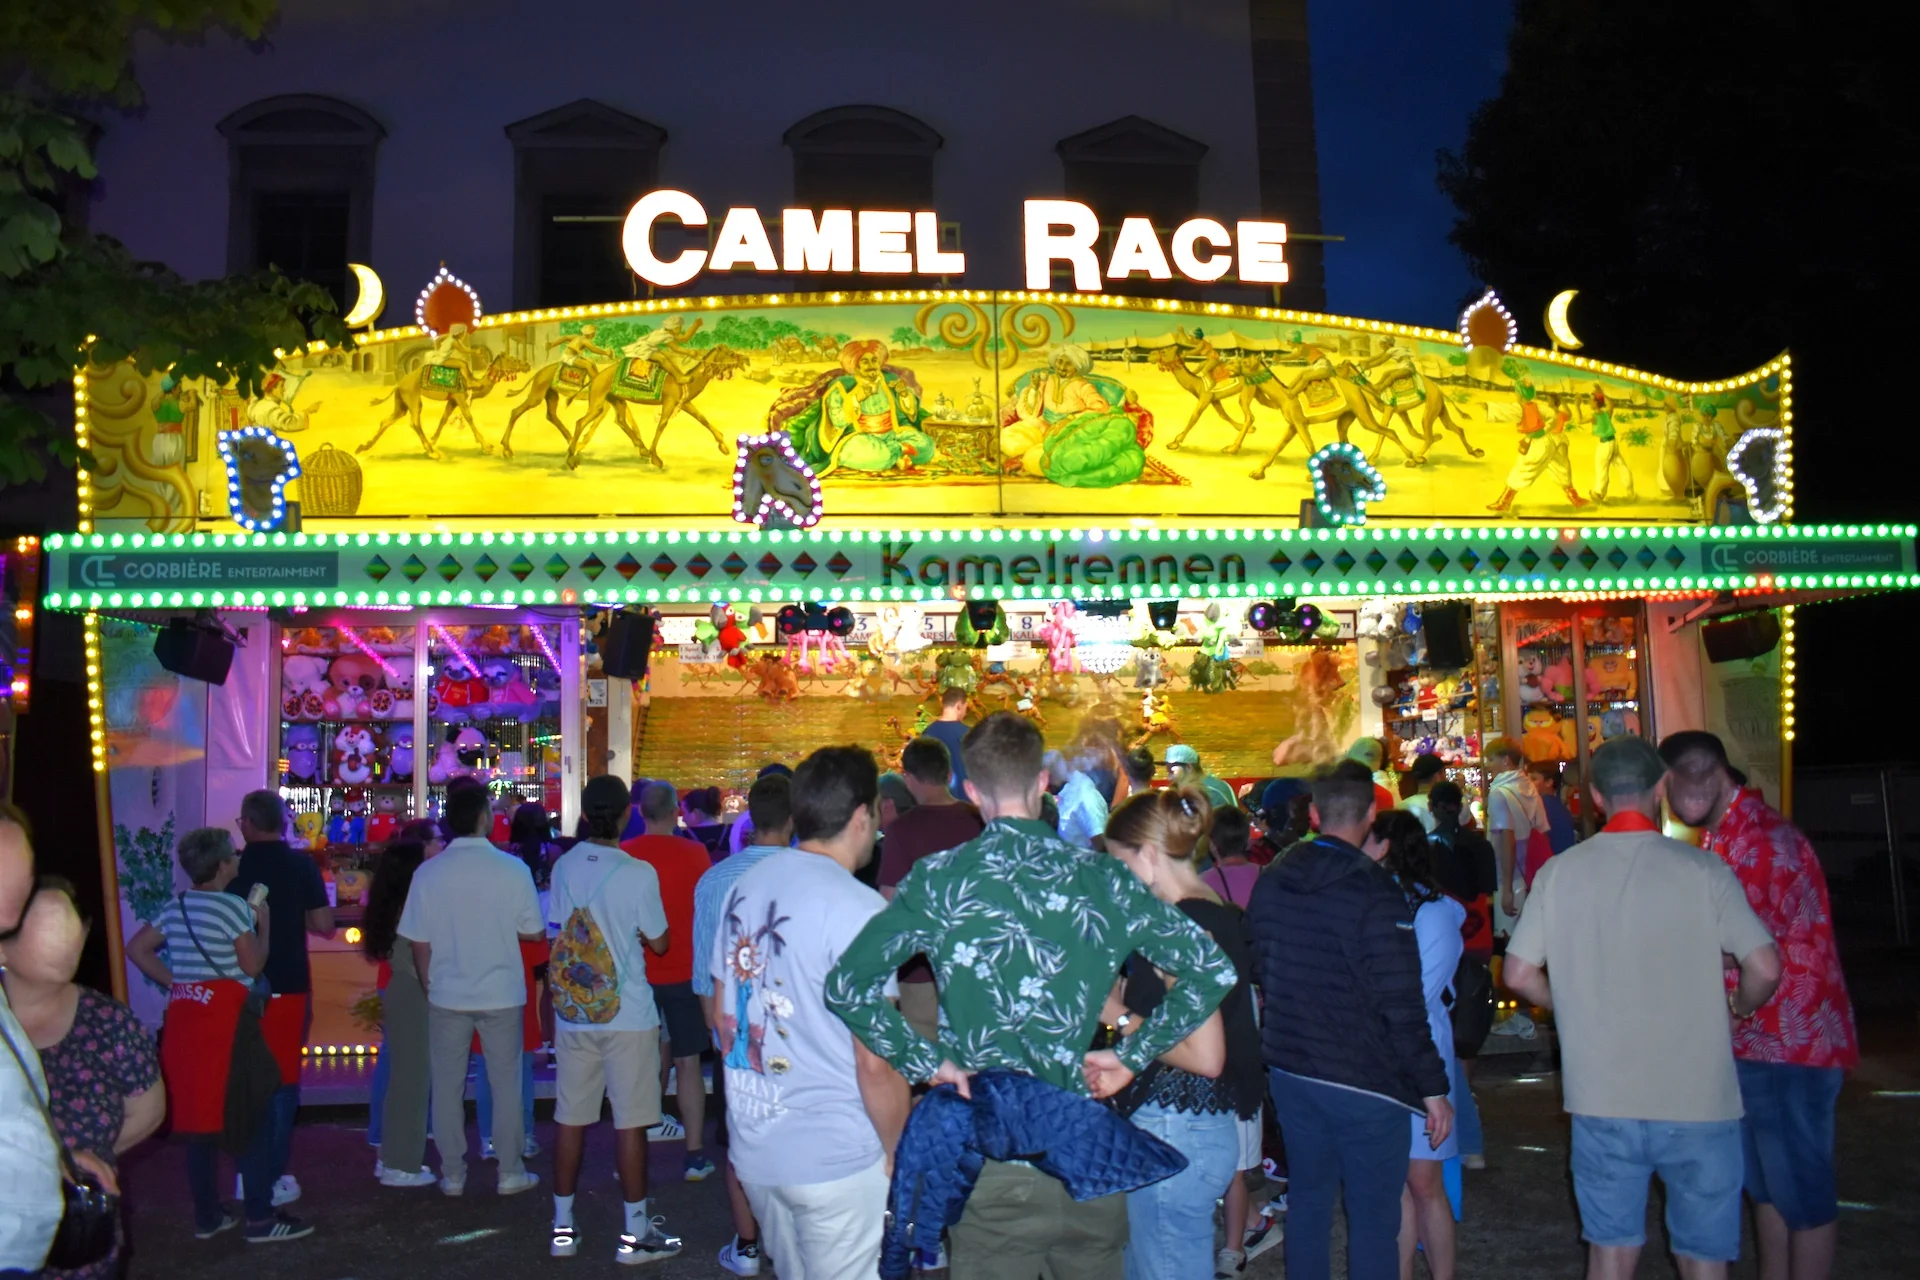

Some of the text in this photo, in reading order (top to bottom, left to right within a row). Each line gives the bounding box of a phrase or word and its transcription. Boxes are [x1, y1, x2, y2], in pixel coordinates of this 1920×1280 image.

[622, 188, 1291, 292] CAMEL RACE
[880, 541, 1247, 587] Kamelrennen
[1743, 546, 1819, 565] CORBIÈRE
[1821, 553, 1895, 565] ENTERTAINMENT
[123, 557, 223, 579] CORBIÈRE
[227, 566, 328, 579] ENTERTAINMENT
[856, 617, 868, 631] 3
[924, 617, 934, 631] 5
[1021, 616, 1033, 630] 8
[172, 983, 214, 1005] UISSE
